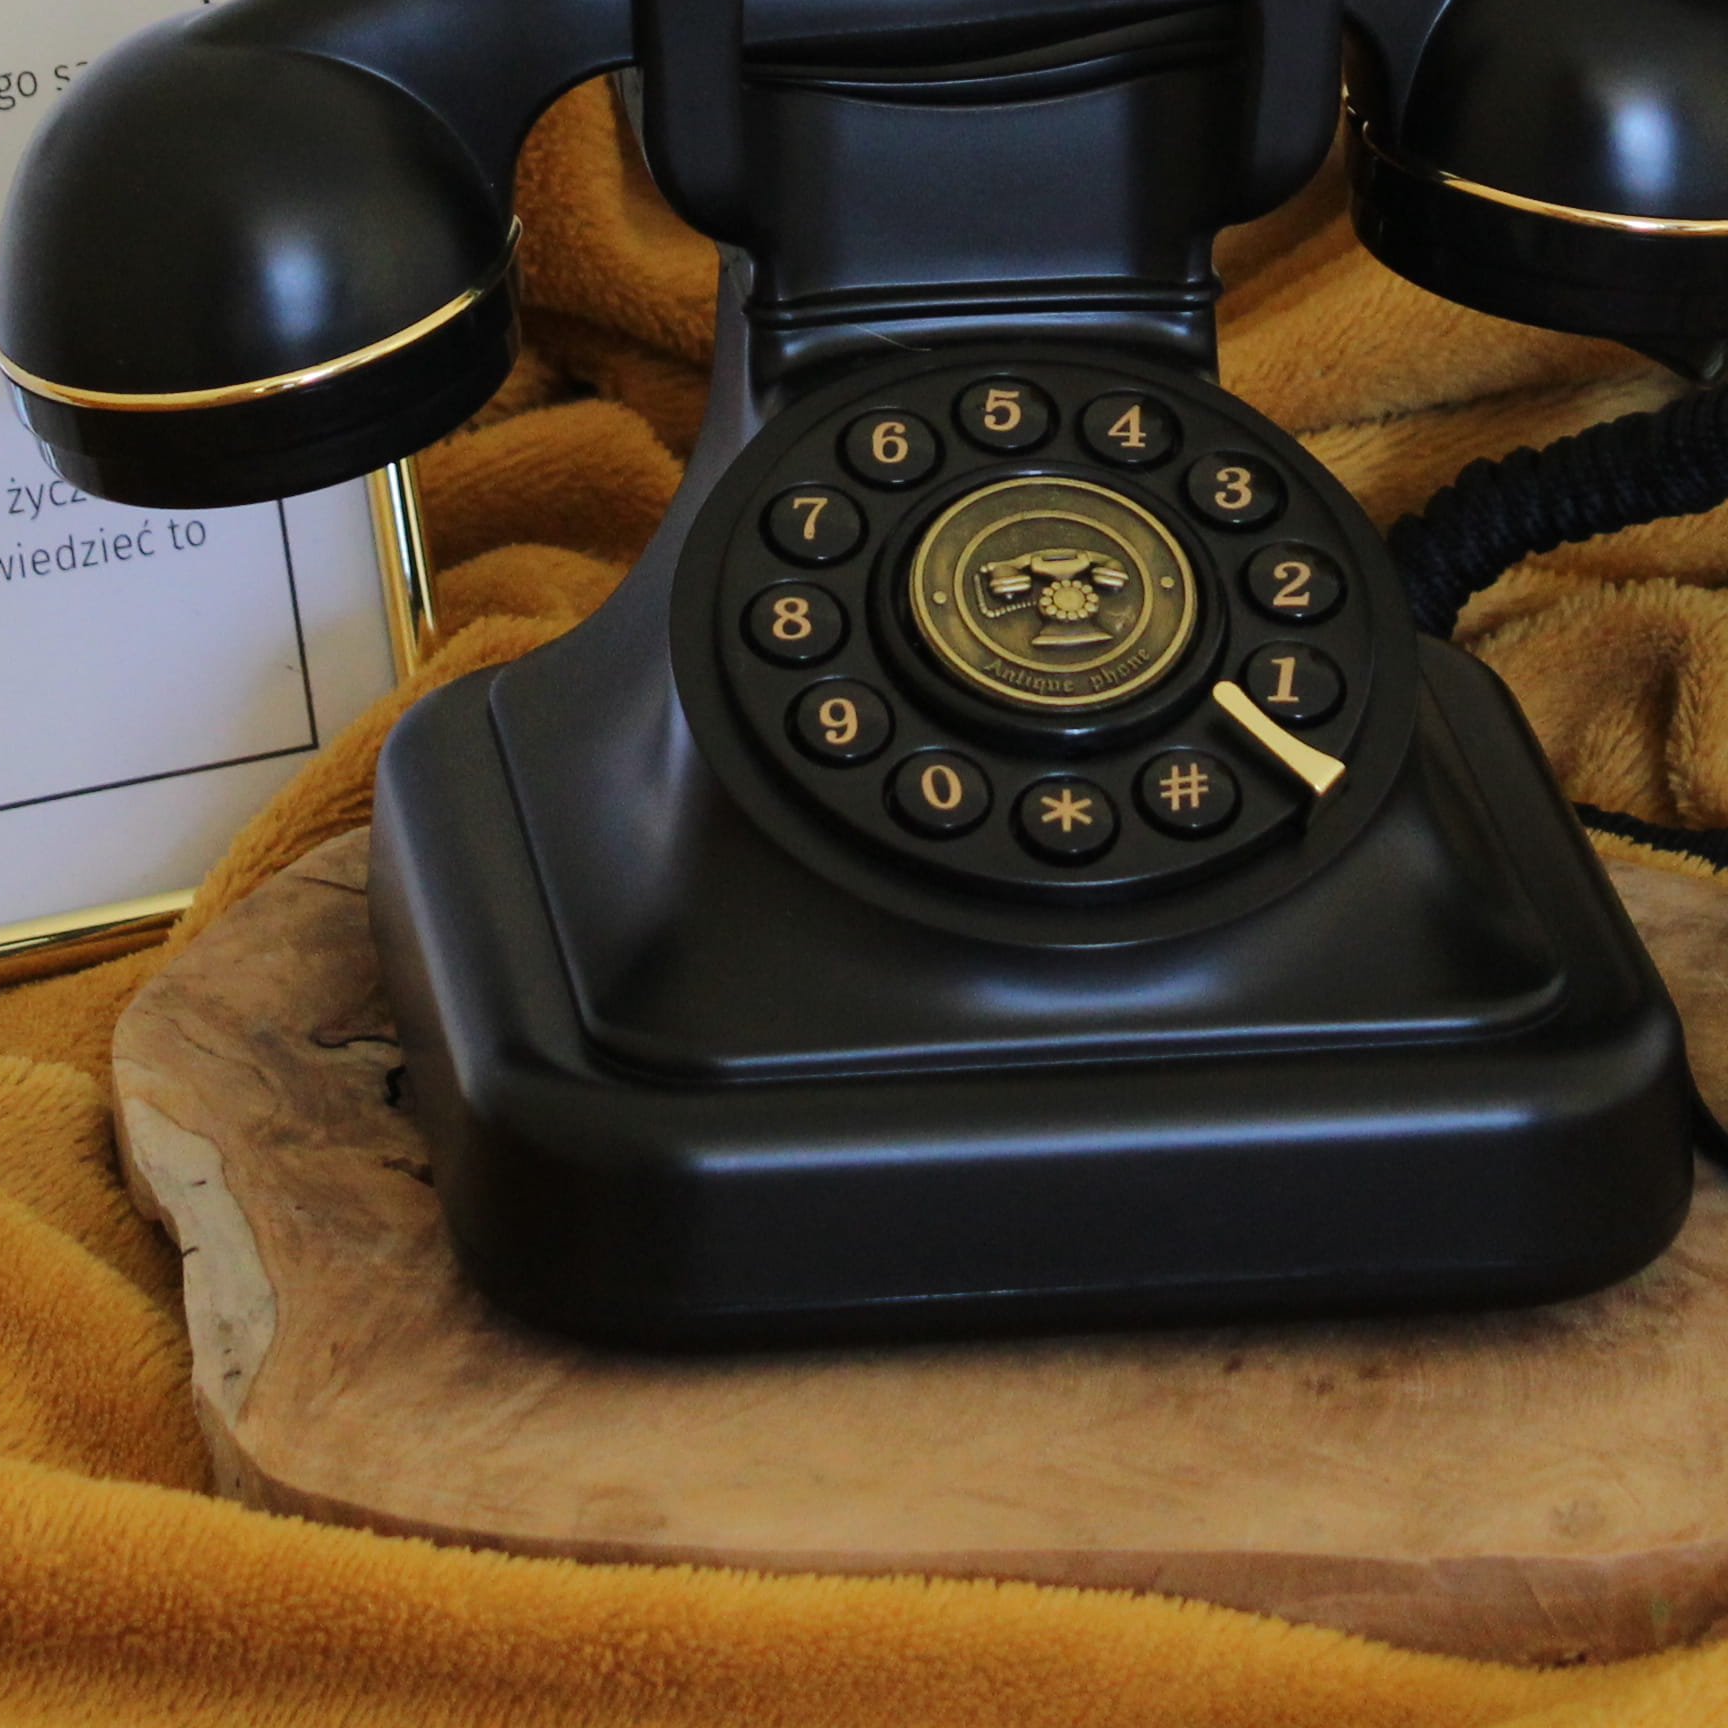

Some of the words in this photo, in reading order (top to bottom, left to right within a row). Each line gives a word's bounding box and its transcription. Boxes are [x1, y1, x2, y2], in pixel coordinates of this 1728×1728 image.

[984, 389, 1021, 432] 5
[1107, 405, 1147, 448] 4
[872, 421, 909, 464] 6
[1214, 467, 1252, 510] 3
[168, 518, 208, 552] to
[793, 497, 828, 540] 7
[1273, 561, 1311, 607] 2
[772, 597, 812, 640] 8
[983, 658, 1074, 694] Antique
[1091, 646, 1150, 691] phone
[1267, 656, 1299, 703] 1
[819, 698, 858, 745] 9
[921, 764, 962, 810] 0
[1159, 763, 1209, 811] #
